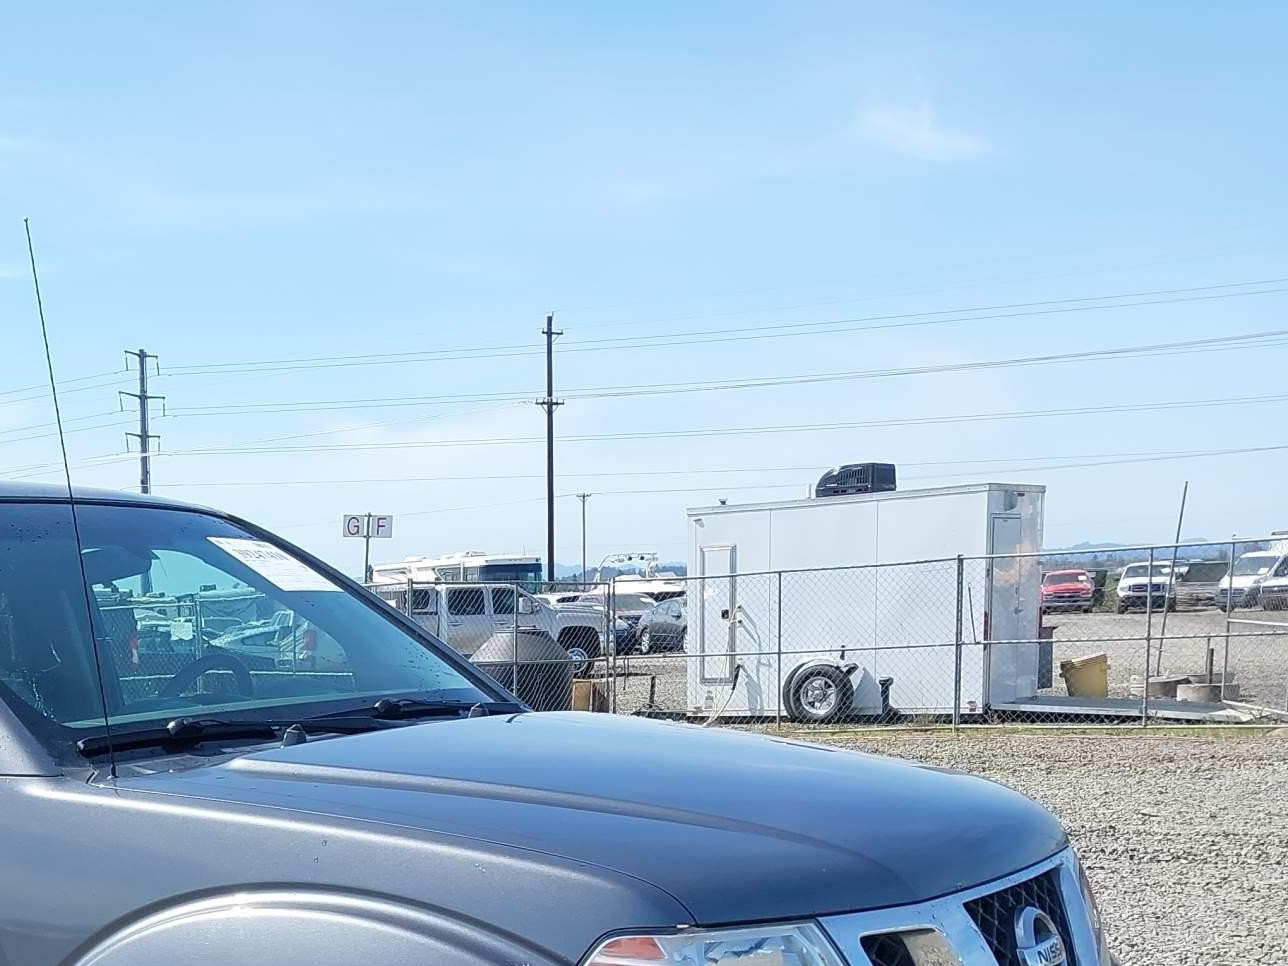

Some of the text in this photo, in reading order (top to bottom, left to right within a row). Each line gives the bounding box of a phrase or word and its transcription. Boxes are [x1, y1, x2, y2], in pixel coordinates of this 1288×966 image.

[347, 516, 360, 536] G
[376, 517, 387, 536] F
[1037, 942, 1062, 963] NISS
